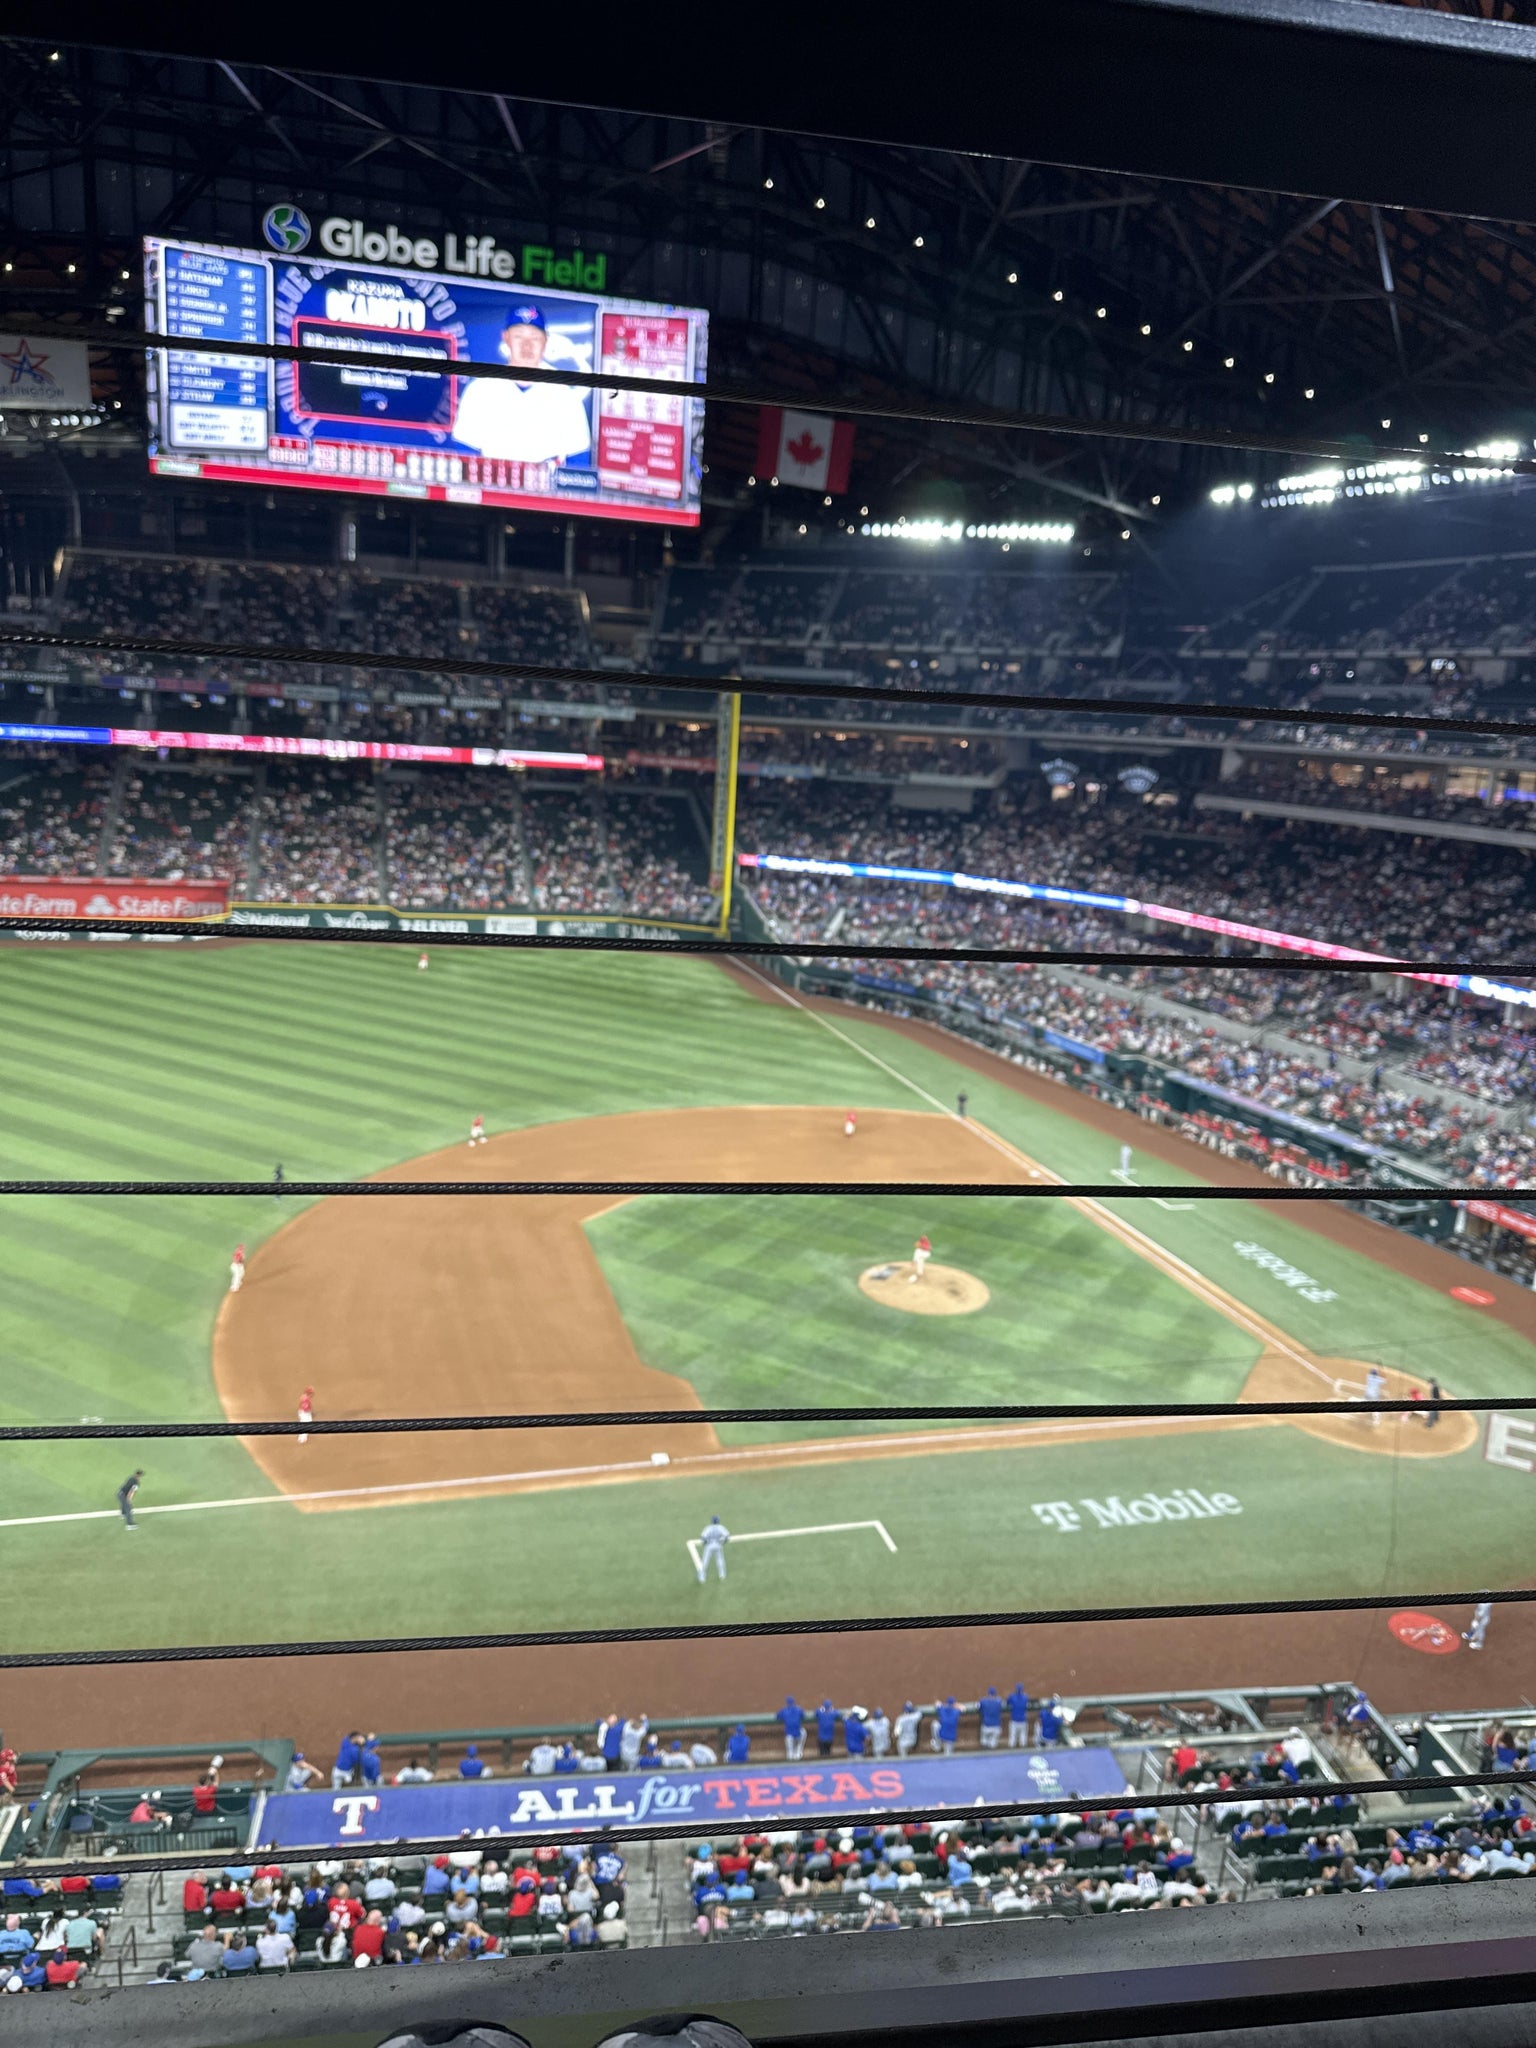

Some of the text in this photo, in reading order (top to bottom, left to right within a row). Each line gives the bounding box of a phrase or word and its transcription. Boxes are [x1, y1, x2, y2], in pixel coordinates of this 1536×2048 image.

[320, 217, 607, 291] Globe Life Field
[347, 278, 406, 298] KAZUMA
[325, 287, 426, 332] OKAMOTO
[0, 385, 65, 400] RLINGTON
[0, 892, 78, 916] teFarm
[1079, 1488, 1245, 1530] Mobile
[332, 1795, 381, 1836] T
[510, 1769, 906, 1824] ALL for TEXAS
